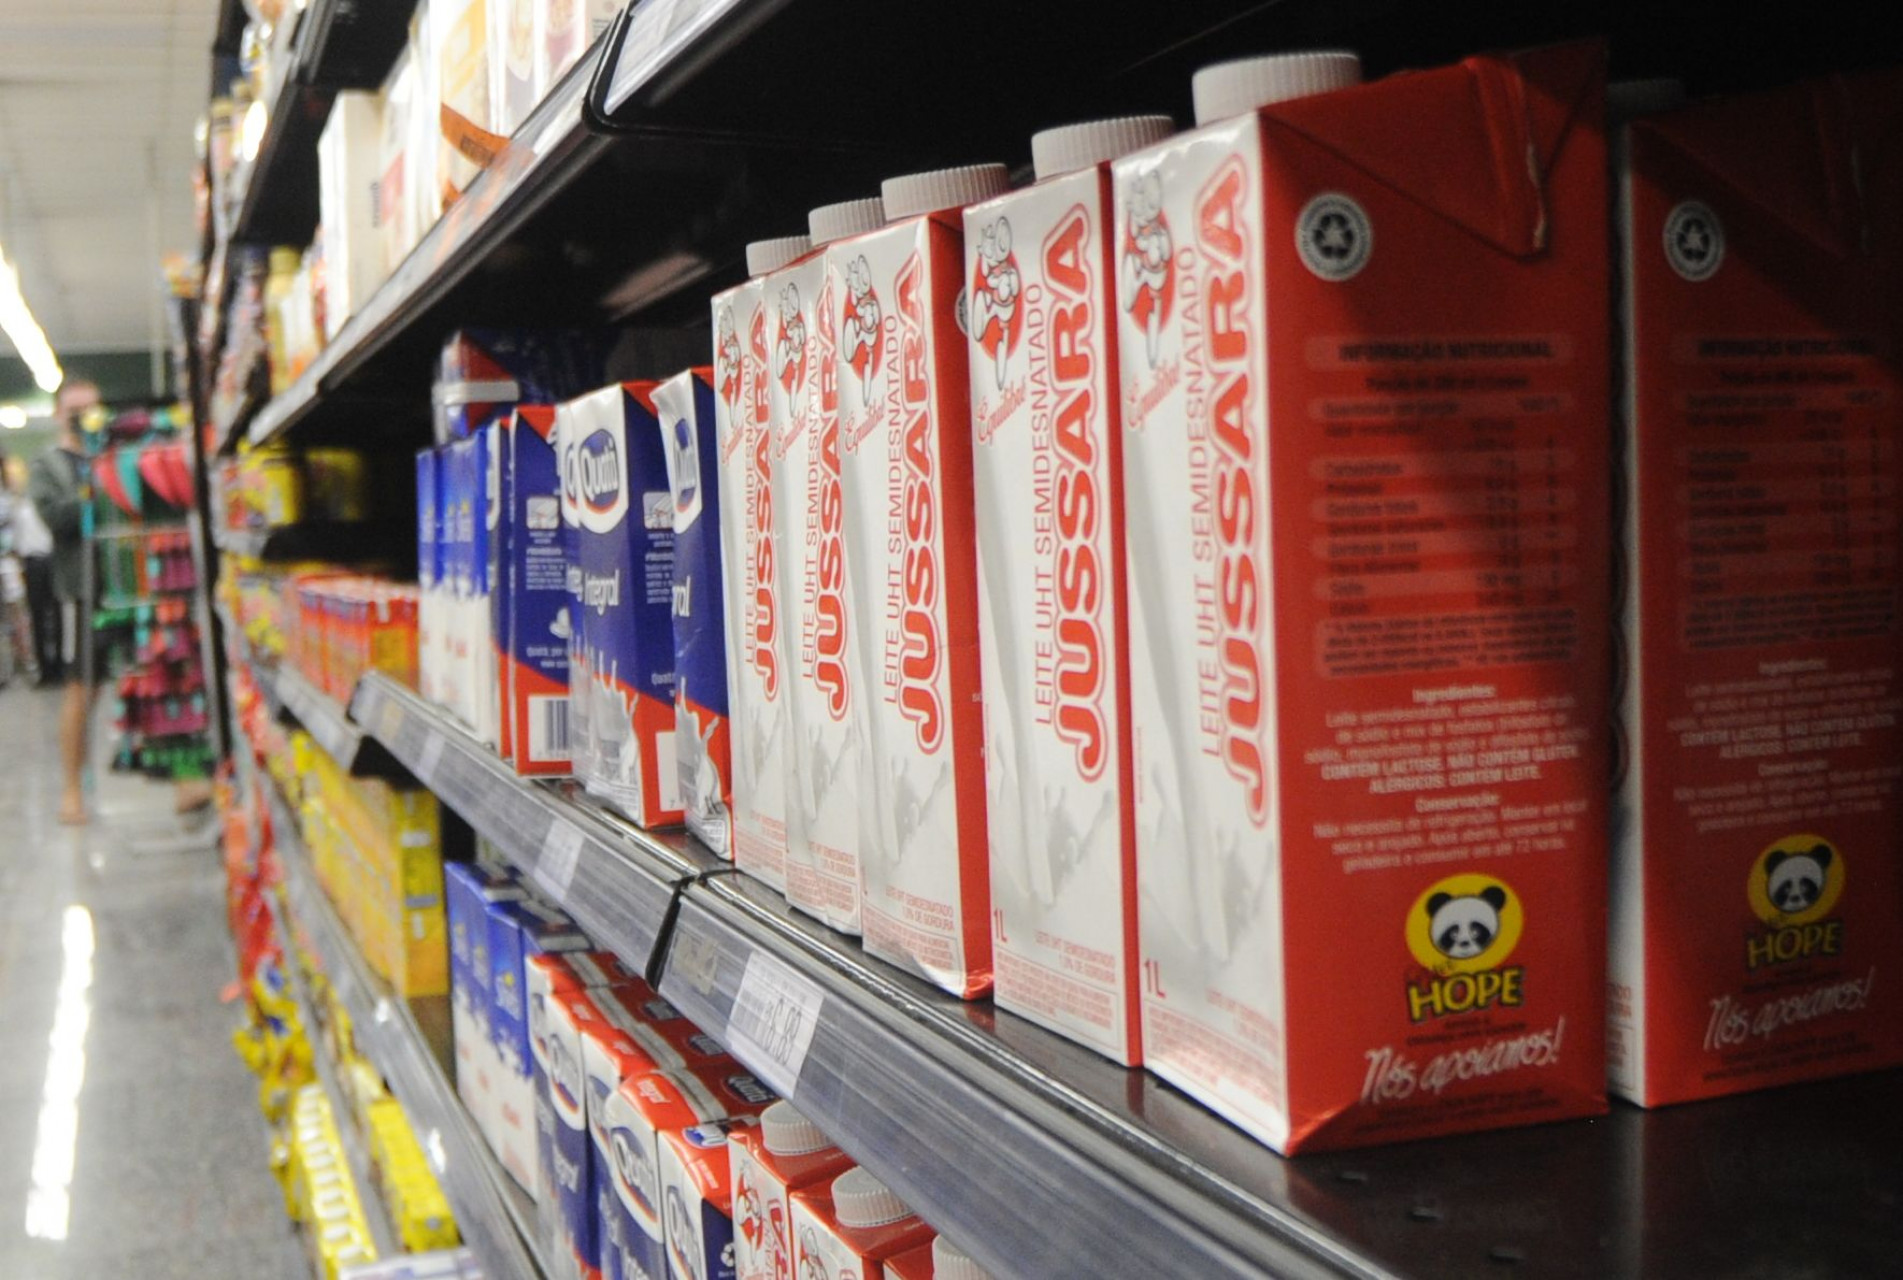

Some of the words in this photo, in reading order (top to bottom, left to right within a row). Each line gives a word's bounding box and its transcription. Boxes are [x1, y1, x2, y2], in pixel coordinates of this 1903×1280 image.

[806, 336, 819, 546] SEMIDESNATADO
[884, 315, 902, 555] SEMIDESNATADO
[1024, 284, 1053, 555] SEMIDESNATADO
[1176, 246, 1215, 562] SEMIDESNATADO
[750, 302, 778, 701] JUSSARA
[815, 275, 848, 721] JUSSARA
[894, 251, 945, 755] JUSSARA
[1042, 203, 1108, 781] JUSSARA
[1195, 154, 1269, 827] JUSSARA
[804, 555, 818, 604] UHT
[886, 564, 902, 619] UHT
[1034, 566, 1053, 629] UHT
[1194, 574, 1217, 646] UHT
[803, 613, 815, 678] LEITE
[884, 629, 900, 704] LEITE
[1035, 640, 1053, 725] LEITE
[1198, 660, 1222, 757] LEITE
[994, 908, 1008, 943] 1L
[1745, 922, 1843, 973] HOPE
[1145, 959, 1166, 998] 1L
[1404, 966, 1524, 1022] HOPE
[1360, 1044, 1418, 1105] Nós
[1420, 1015, 1566, 1095] apoiamos!
[1703, 995, 1750, 1052] Nós
